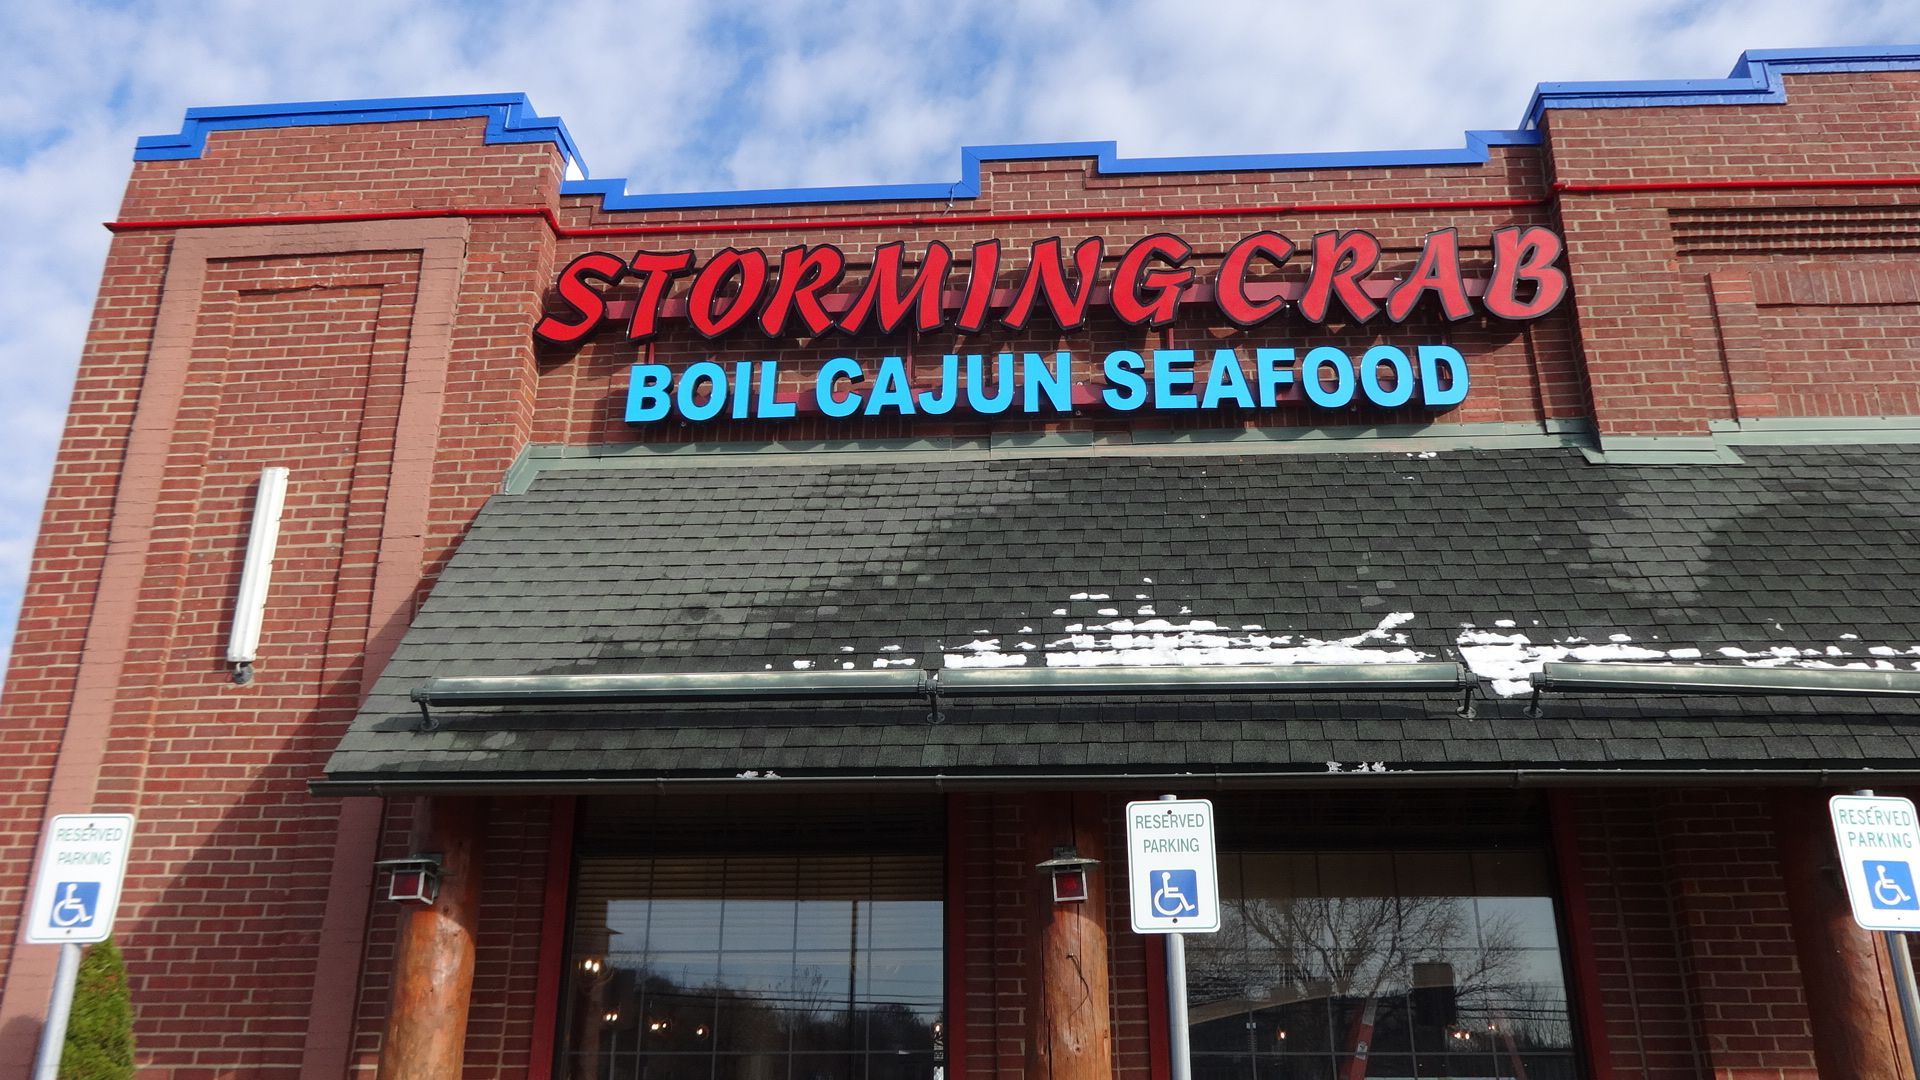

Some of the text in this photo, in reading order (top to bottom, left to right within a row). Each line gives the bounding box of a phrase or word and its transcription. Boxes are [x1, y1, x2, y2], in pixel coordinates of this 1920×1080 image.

[534, 225, 1568, 342] STORMING CRAB
[625, 345, 1470, 424] BOIL CAJUN SEAFOOD
[1136, 813, 1204, 829] RESERVED
[1839, 809, 1910, 826] RESERVED
[57, 828, 122, 841] RESERVED
[1848, 832, 1912, 848] PARKING
[1143, 838, 1200, 853] PARKING
[58, 851, 111, 864] PARKING
